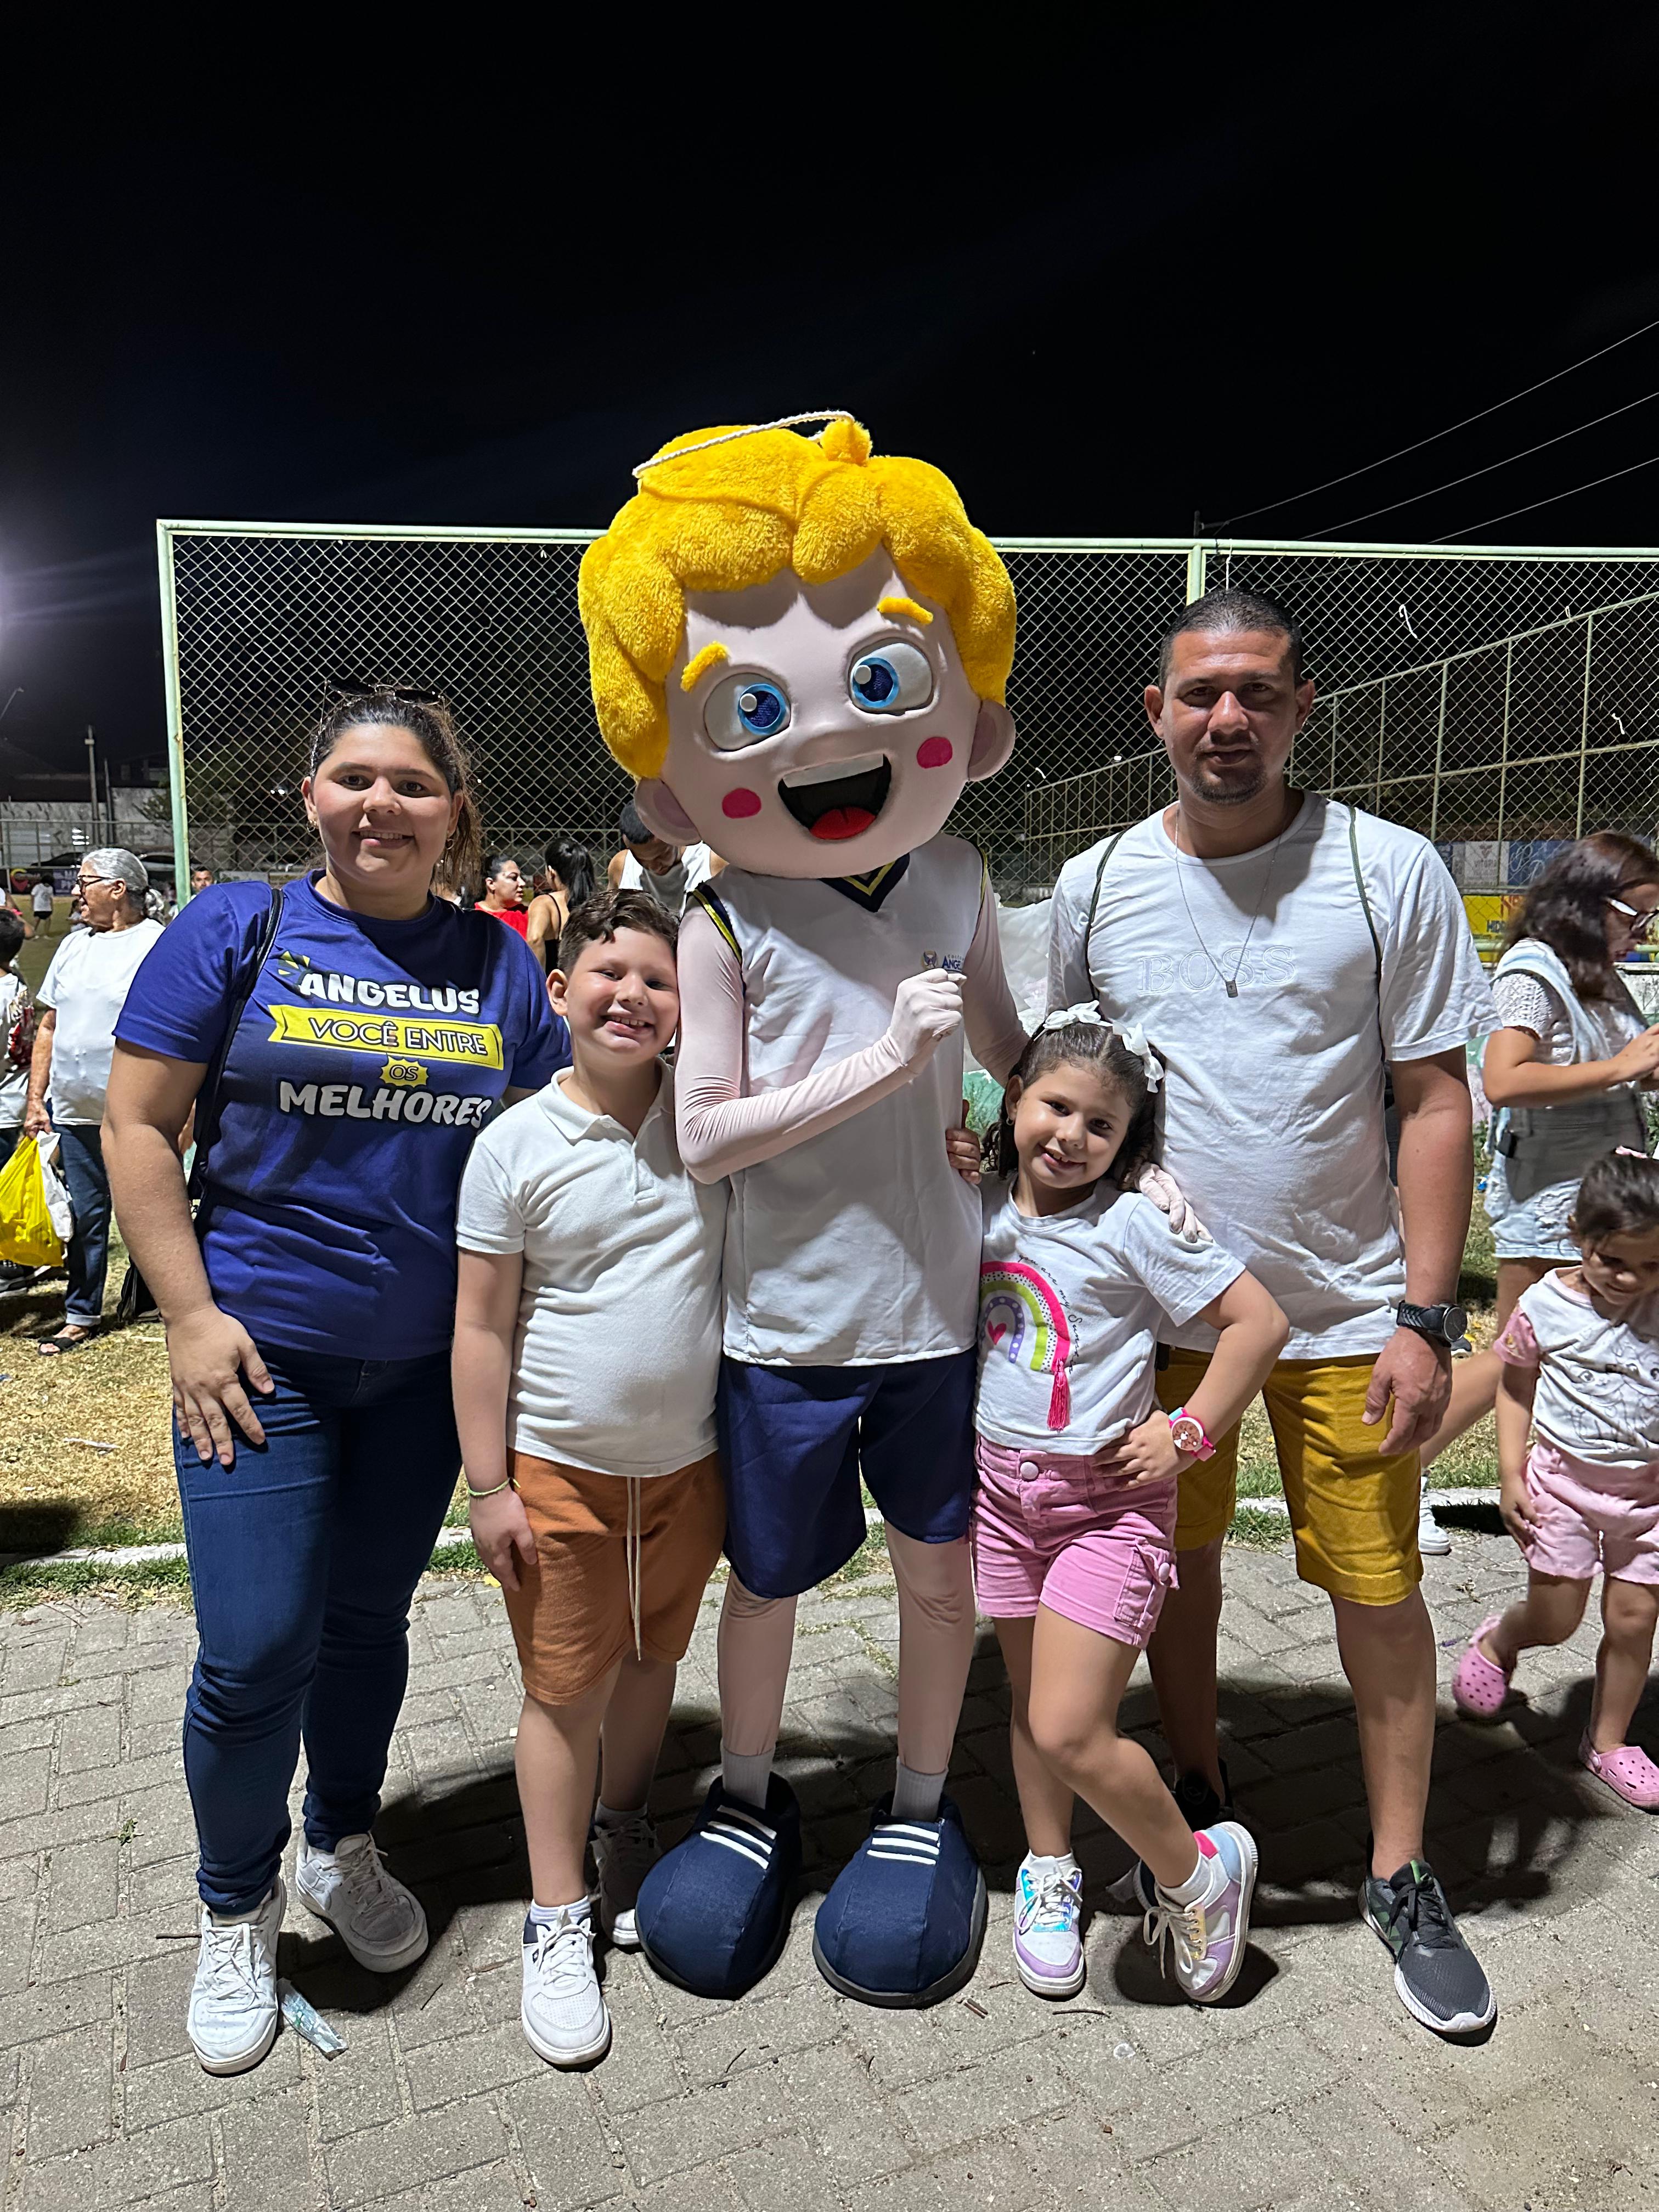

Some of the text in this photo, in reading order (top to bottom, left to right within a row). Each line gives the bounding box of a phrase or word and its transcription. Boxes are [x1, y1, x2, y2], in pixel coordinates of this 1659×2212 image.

[1138, 945, 1296, 996] BOSS
[297, 972, 481, 1015] ANGELUS
[308, 1017, 487, 1055] VOCÊ ENTRE
[390, 1064, 418, 1081] OS
[279, 1081, 492, 1128] MELHORES
[1041, 1267, 1058, 1285] are
[1059, 1289, 1071, 1310] my
